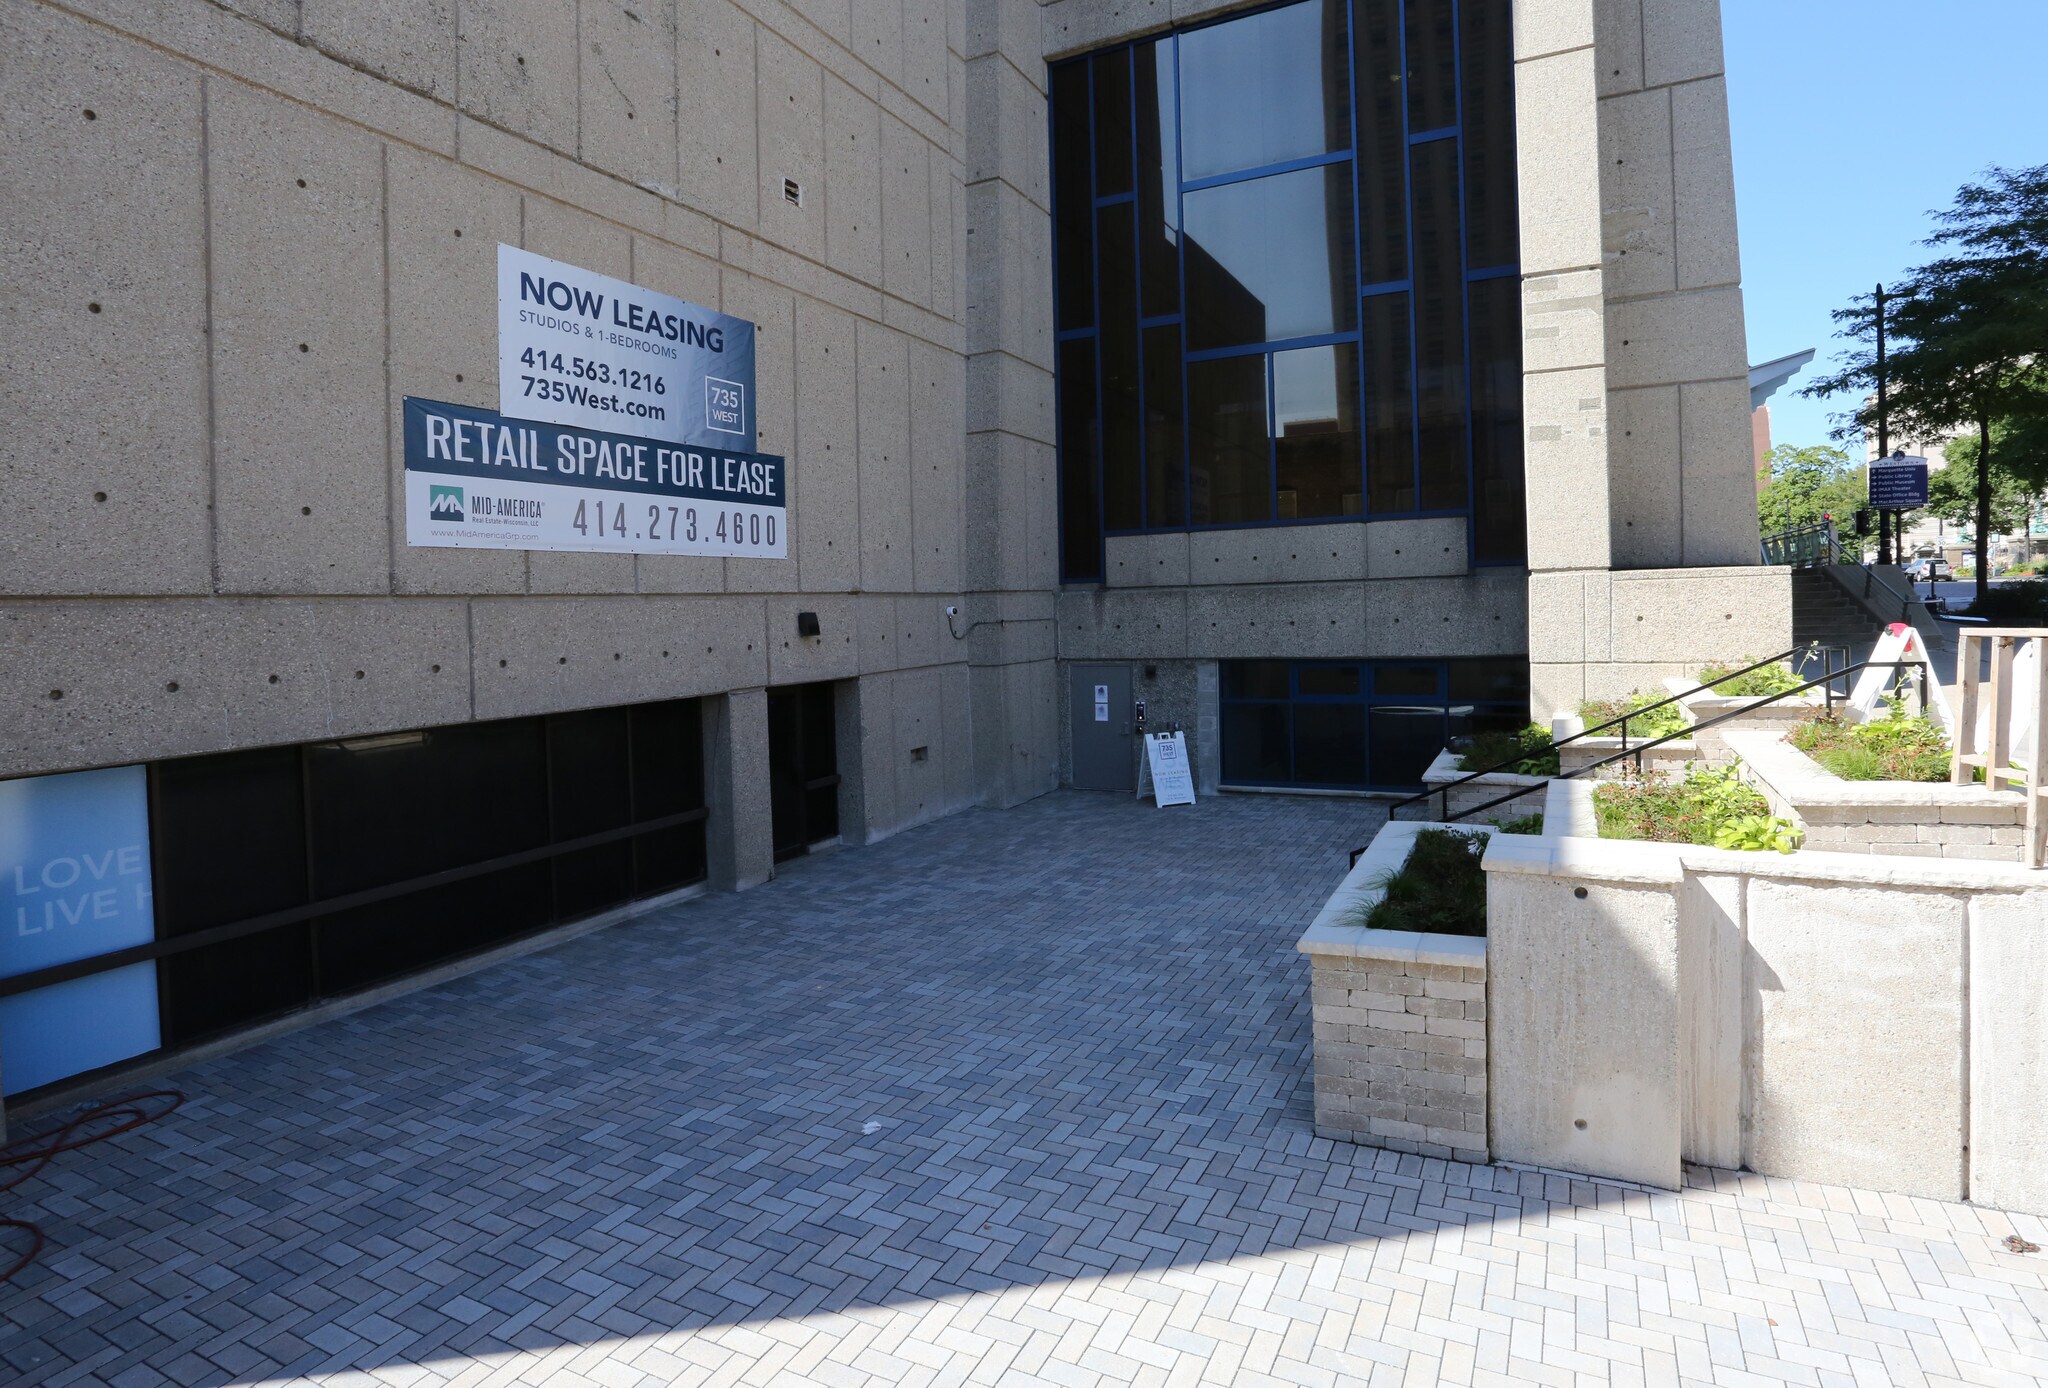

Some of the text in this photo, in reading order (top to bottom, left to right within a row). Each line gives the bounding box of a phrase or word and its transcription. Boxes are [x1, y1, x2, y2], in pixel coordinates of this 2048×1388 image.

[519, 309, 678, 360] STUDIOS & 1-BEDROOMS
[520, 271, 724, 353] NOW LEASING
[521, 346, 666, 395] 414.563.1216
[521, 375, 666, 421] 735West.com
[711, 387, 738, 408] 735
[713, 409, 738, 424] WEST
[426, 414, 776, 497] RETAIL SPACE FOR LEASE
[471, 495, 542, 519] MID-AMERICA
[472, 516, 485, 524] Real
[572, 498, 776, 547] 414.273.4600
[431, 529, 540, 541] www.MidAmericaGrp.com
[14, 845, 143, 896] LOVE
[16, 888, 119, 937] LIVE
